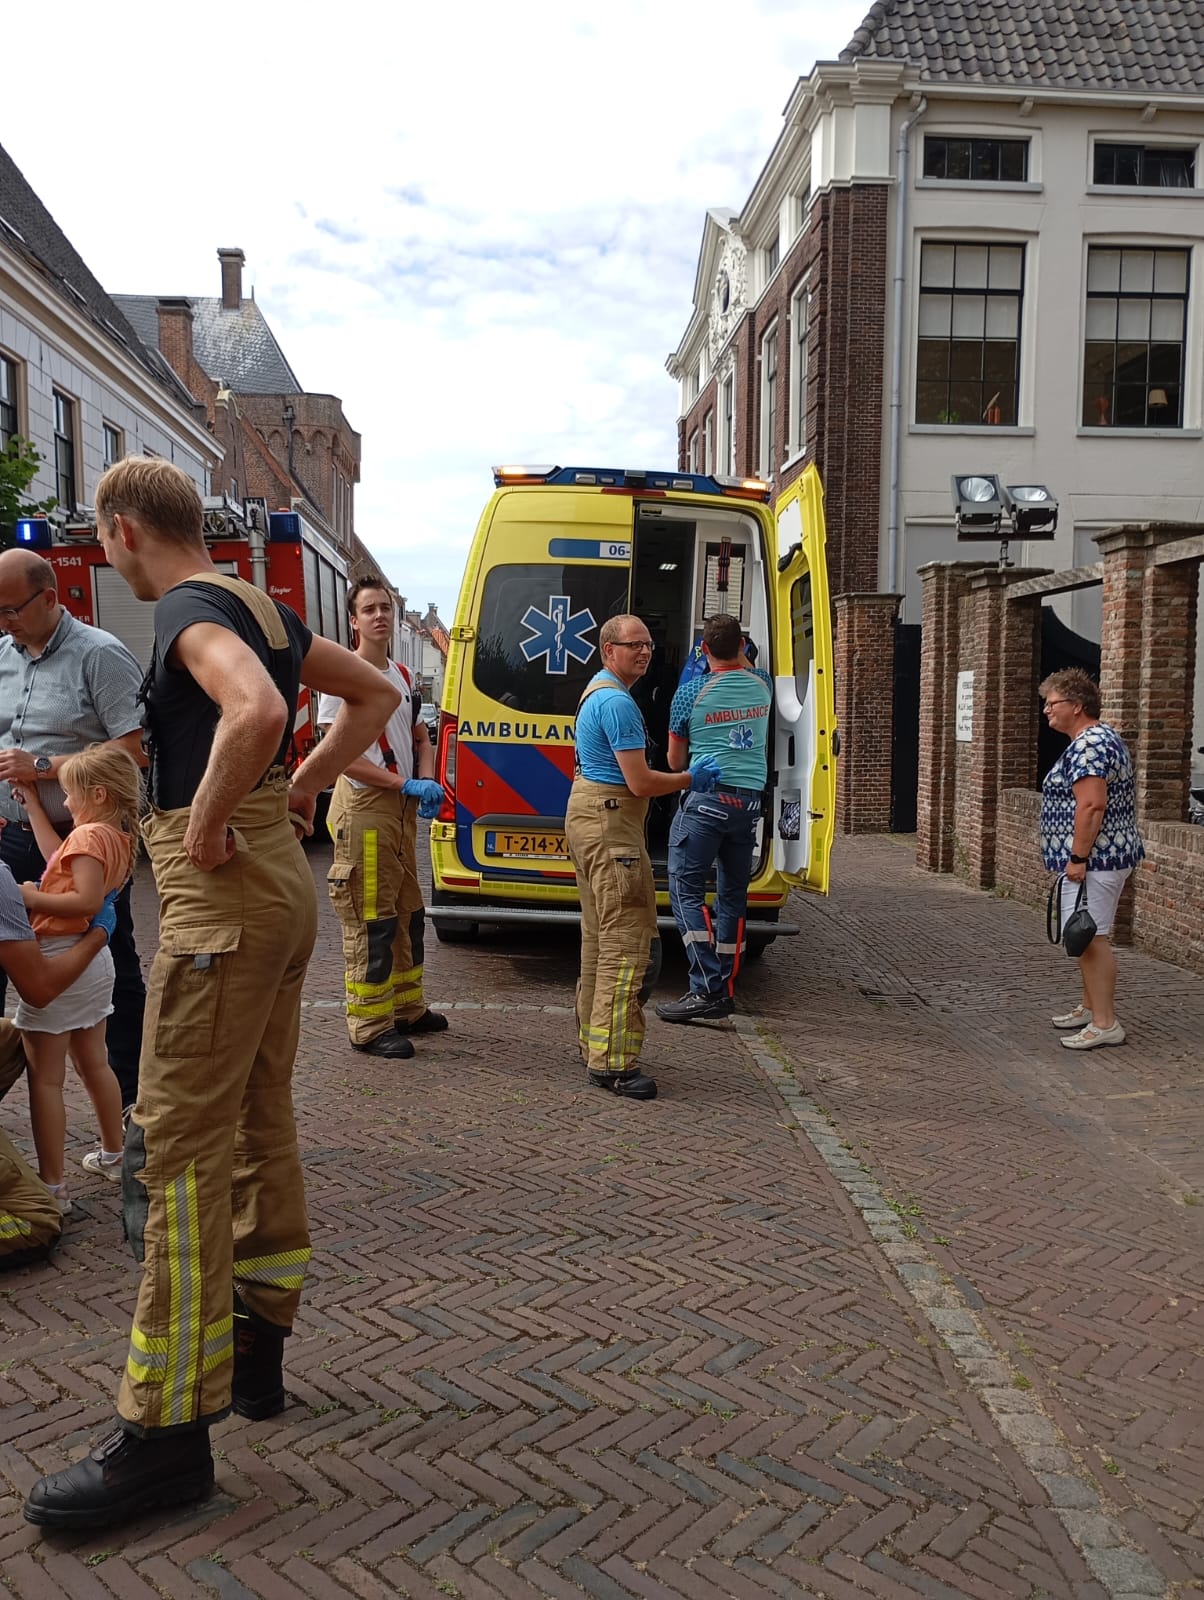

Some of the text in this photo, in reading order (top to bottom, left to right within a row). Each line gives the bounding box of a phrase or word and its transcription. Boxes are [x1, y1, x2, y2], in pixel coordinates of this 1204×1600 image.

[609, 544, 631, 556] 06-
[704, 704, 769, 725] AMBULANCE
[504, 835, 569, 853] T-214-X
